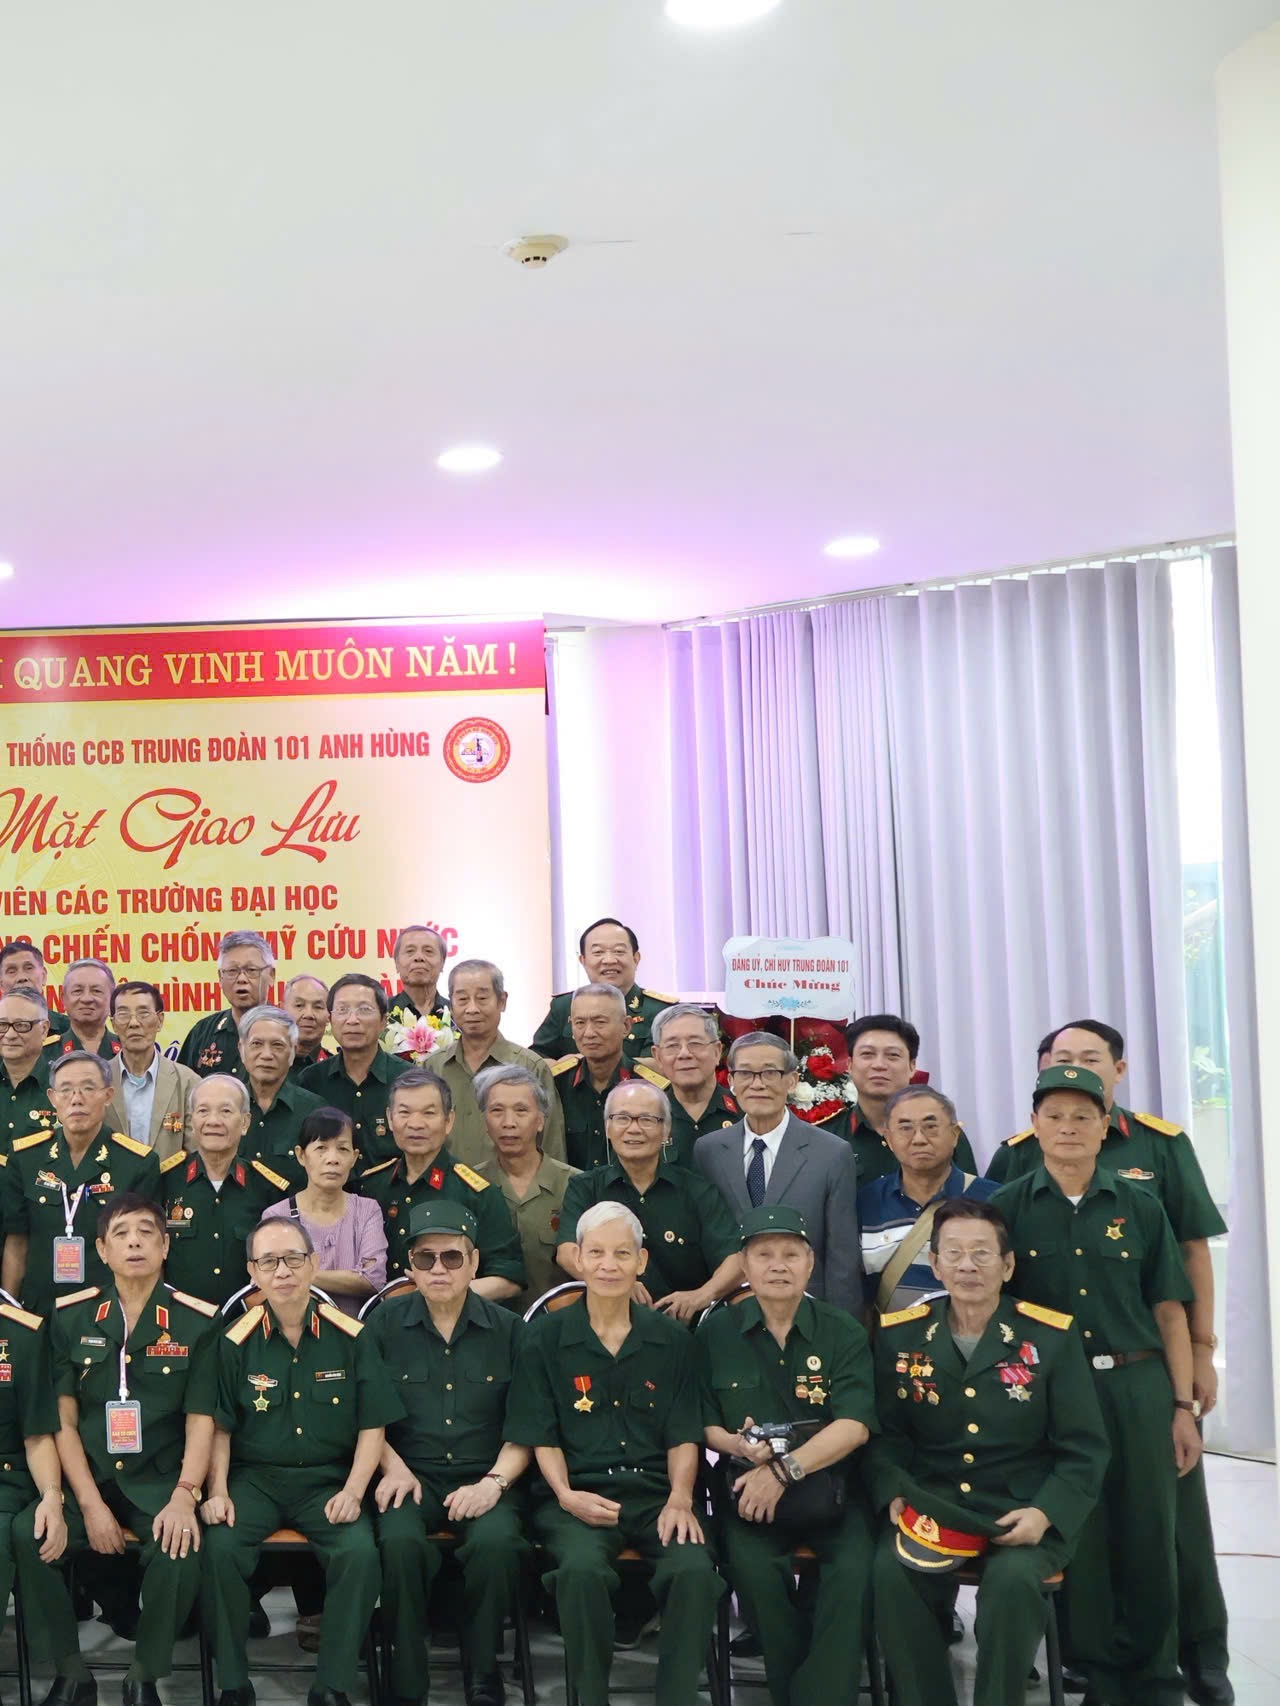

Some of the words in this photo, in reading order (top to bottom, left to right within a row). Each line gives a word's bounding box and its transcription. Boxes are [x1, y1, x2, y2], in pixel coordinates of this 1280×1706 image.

[14, 654, 152, 691] QUANG
[164, 652, 264, 683] VINH
[276, 637, 394, 680] MUÔN
[405, 636, 499, 677] NĂM
[508, 640, 517, 674] !
[8, 734, 75, 765] THỐNG
[84, 740, 124, 763] CCB
[133, 738, 201, 762] TRUNG
[208, 731, 266, 761] ĐOÀN
[275, 736, 309, 759] 101
[320, 734, 363, 758] ANH
[371, 727, 429, 757] HÙNG
[121, 788, 255, 868] Giao
[262, 780, 358, 862] Lưu
[57, 884, 108, 914] CÁC
[119, 881, 222, 912] TRƯỜNG
[232, 886, 274, 916] ĐẠI
[286, 885, 337, 916] HỌC
[43, 924, 131, 964] CHIẾN
[141, 921, 236, 963] CHỐN
[308, 923, 366, 959] CỨU
[744, 978, 787, 989] Chúc
[793, 978, 841, 992] Mừng
[778, 959, 790, 973] HUY
[793, 959, 815, 973] TRUNG
[838, 960, 849, 973] 101
